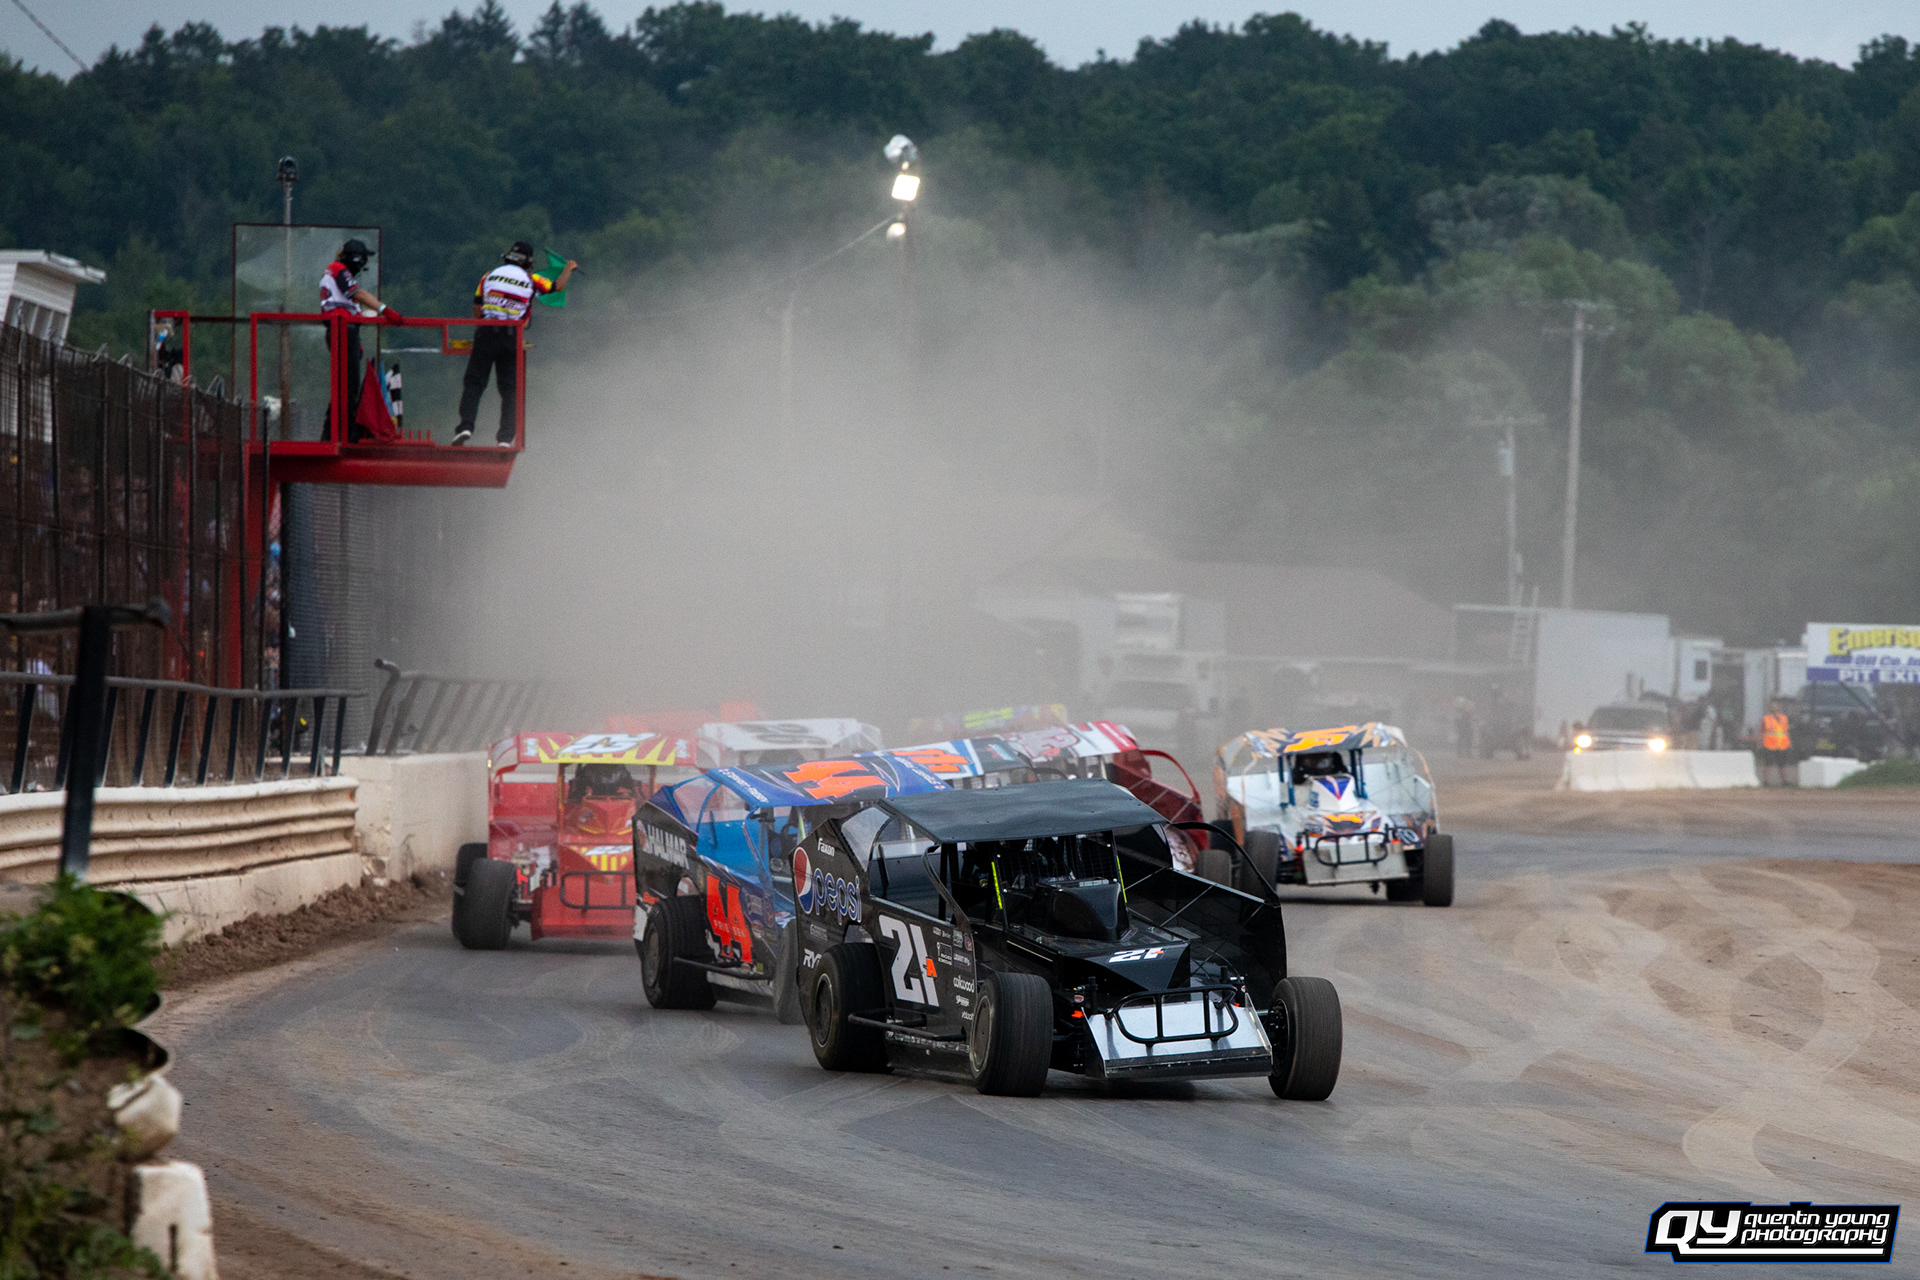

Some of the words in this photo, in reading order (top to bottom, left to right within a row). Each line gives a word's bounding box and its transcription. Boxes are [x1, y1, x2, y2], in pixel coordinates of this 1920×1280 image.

[488, 275, 530, 288] OFFICIAL
[1839, 668, 1872, 682] PIT
[644, 823, 690, 870] HALMAR
[817, 838, 836, 857] Faxon
[813, 867, 862, 926] pepsi
[706, 874, 753, 964] 44
